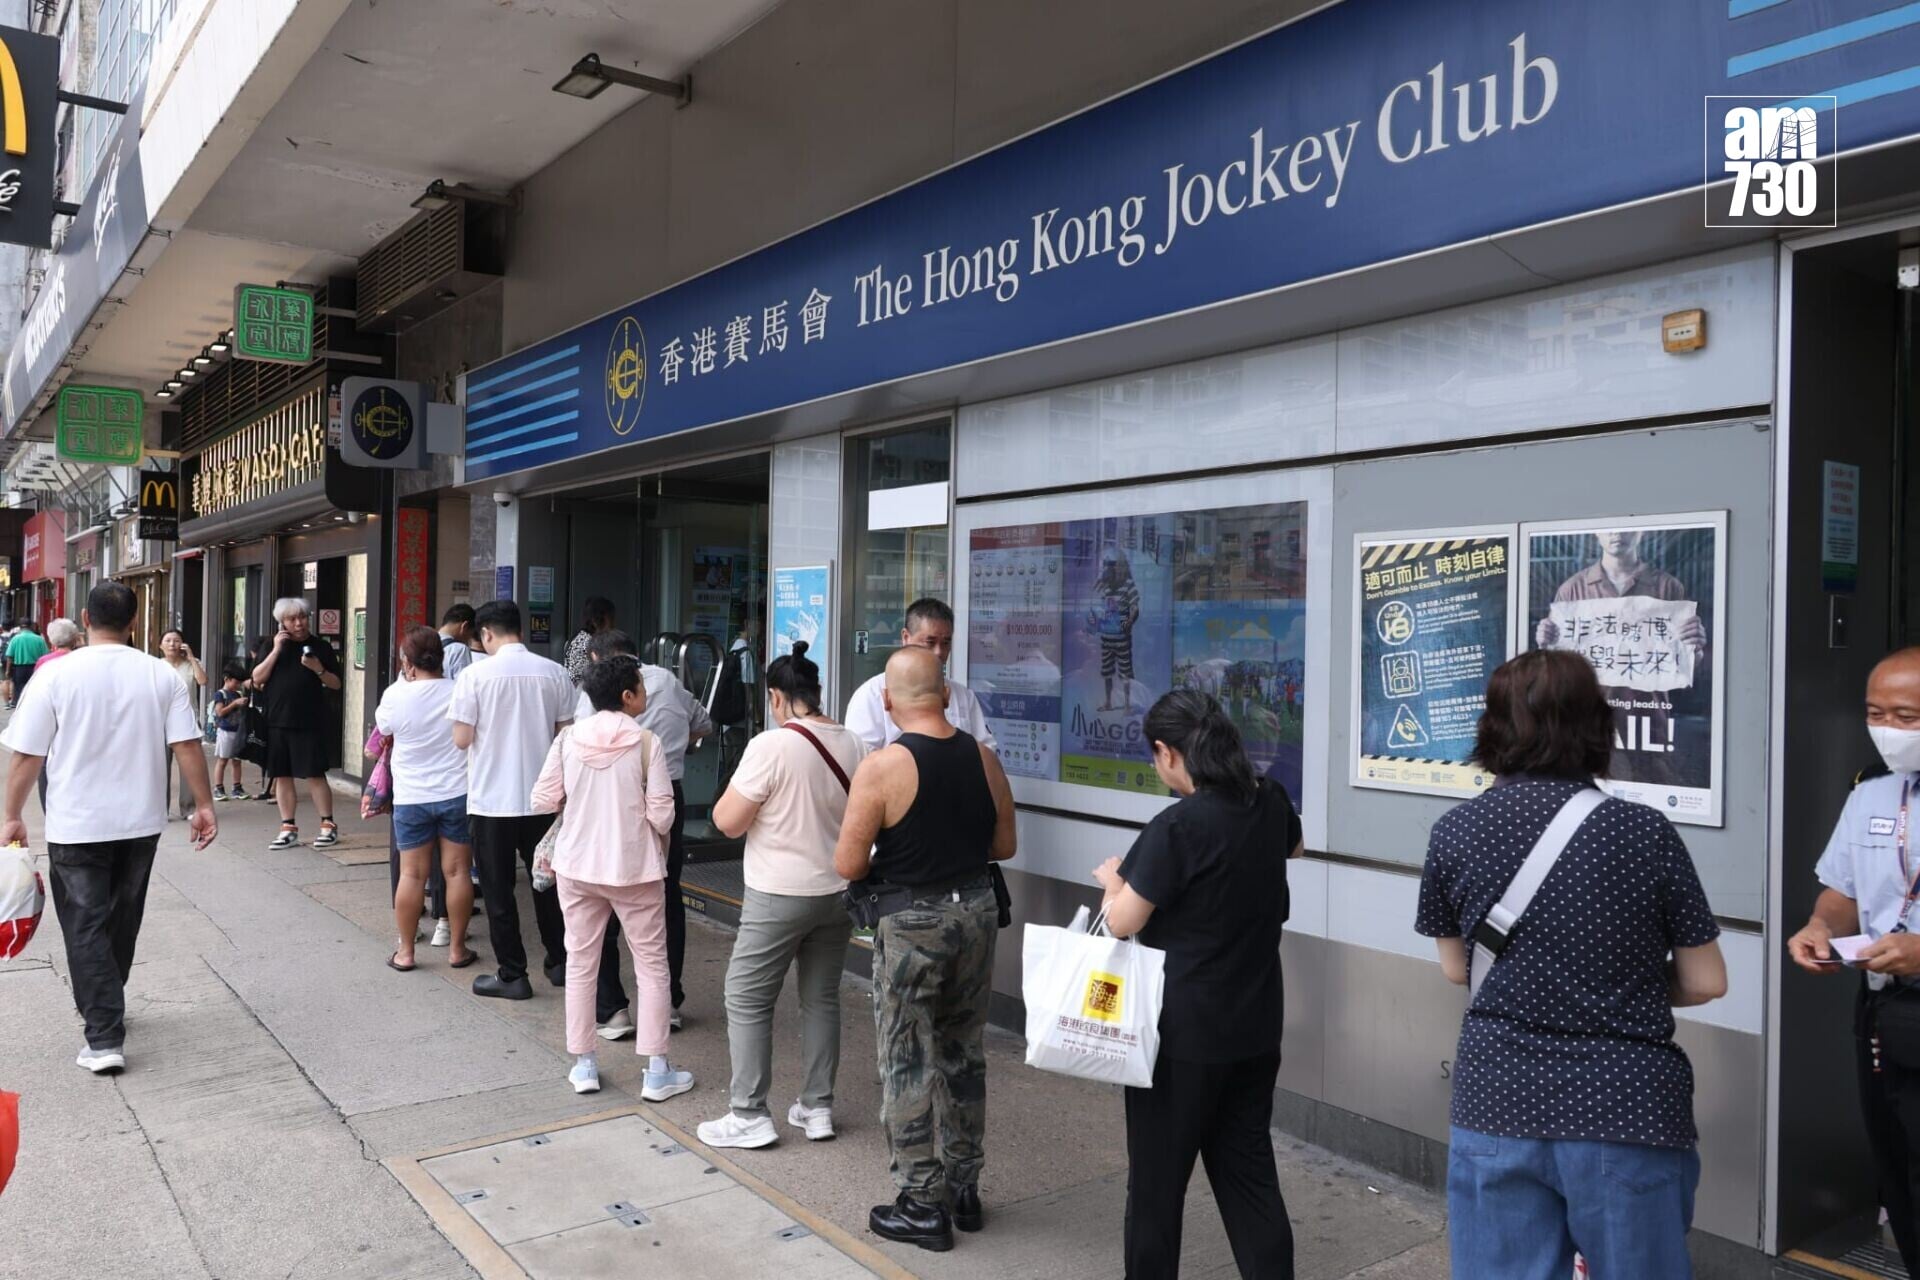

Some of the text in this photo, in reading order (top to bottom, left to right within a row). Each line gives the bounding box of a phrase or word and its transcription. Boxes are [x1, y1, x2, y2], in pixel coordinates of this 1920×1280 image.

[659, 31, 1559, 387] 香港賽馬會 The Hong Kong Jockey Club
[1364, 545, 1506, 591] 適可而止 時刻自律
[1366, 590, 1383, 600] Don't
[1384, 586, 1410, 597] Gamble
[1444, 576, 1463, 585] Know
[1464, 572, 1481, 582] your
[1483, 568, 1507, 577] Limits.
[1607, 699, 1672, 710] tting leads to
